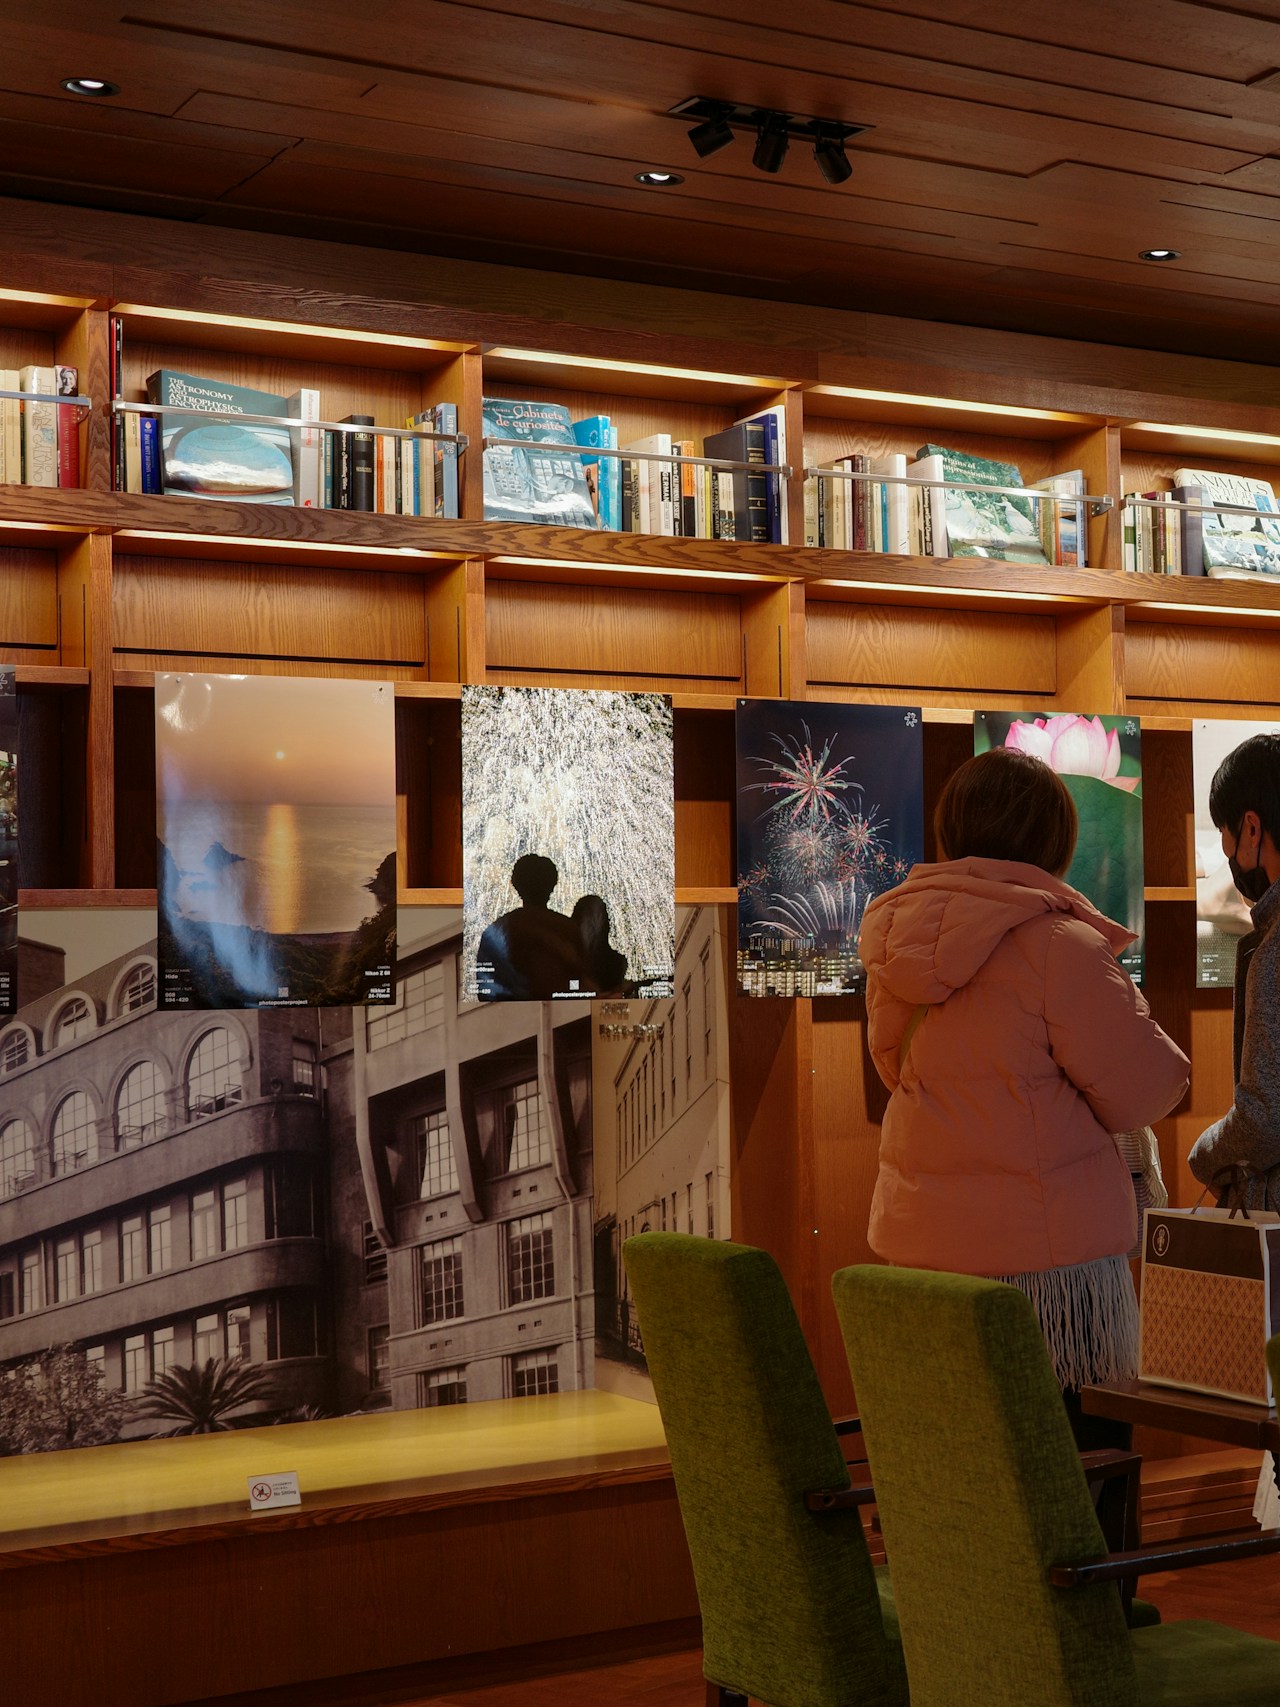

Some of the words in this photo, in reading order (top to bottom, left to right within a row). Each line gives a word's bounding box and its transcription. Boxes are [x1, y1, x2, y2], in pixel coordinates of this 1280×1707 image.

[168, 377, 184, 385] THE
[168, 382, 234, 401] ASTRONOMY
[168, 389, 187, 397] AND
[168, 393, 243, 413] ASTROPHYSICS
[512, 405, 564, 421] Cabinets
[496, 416, 510, 426] de
[512, 420, 567, 432] curiosités
[943, 456, 967, 469] rigins
[967, 462, 976, 470] of
[943, 463, 998, 481] mpressionism
[662, 471, 671, 502] GERMAN
[1190, 473, 1268, 495] ANIMALS
